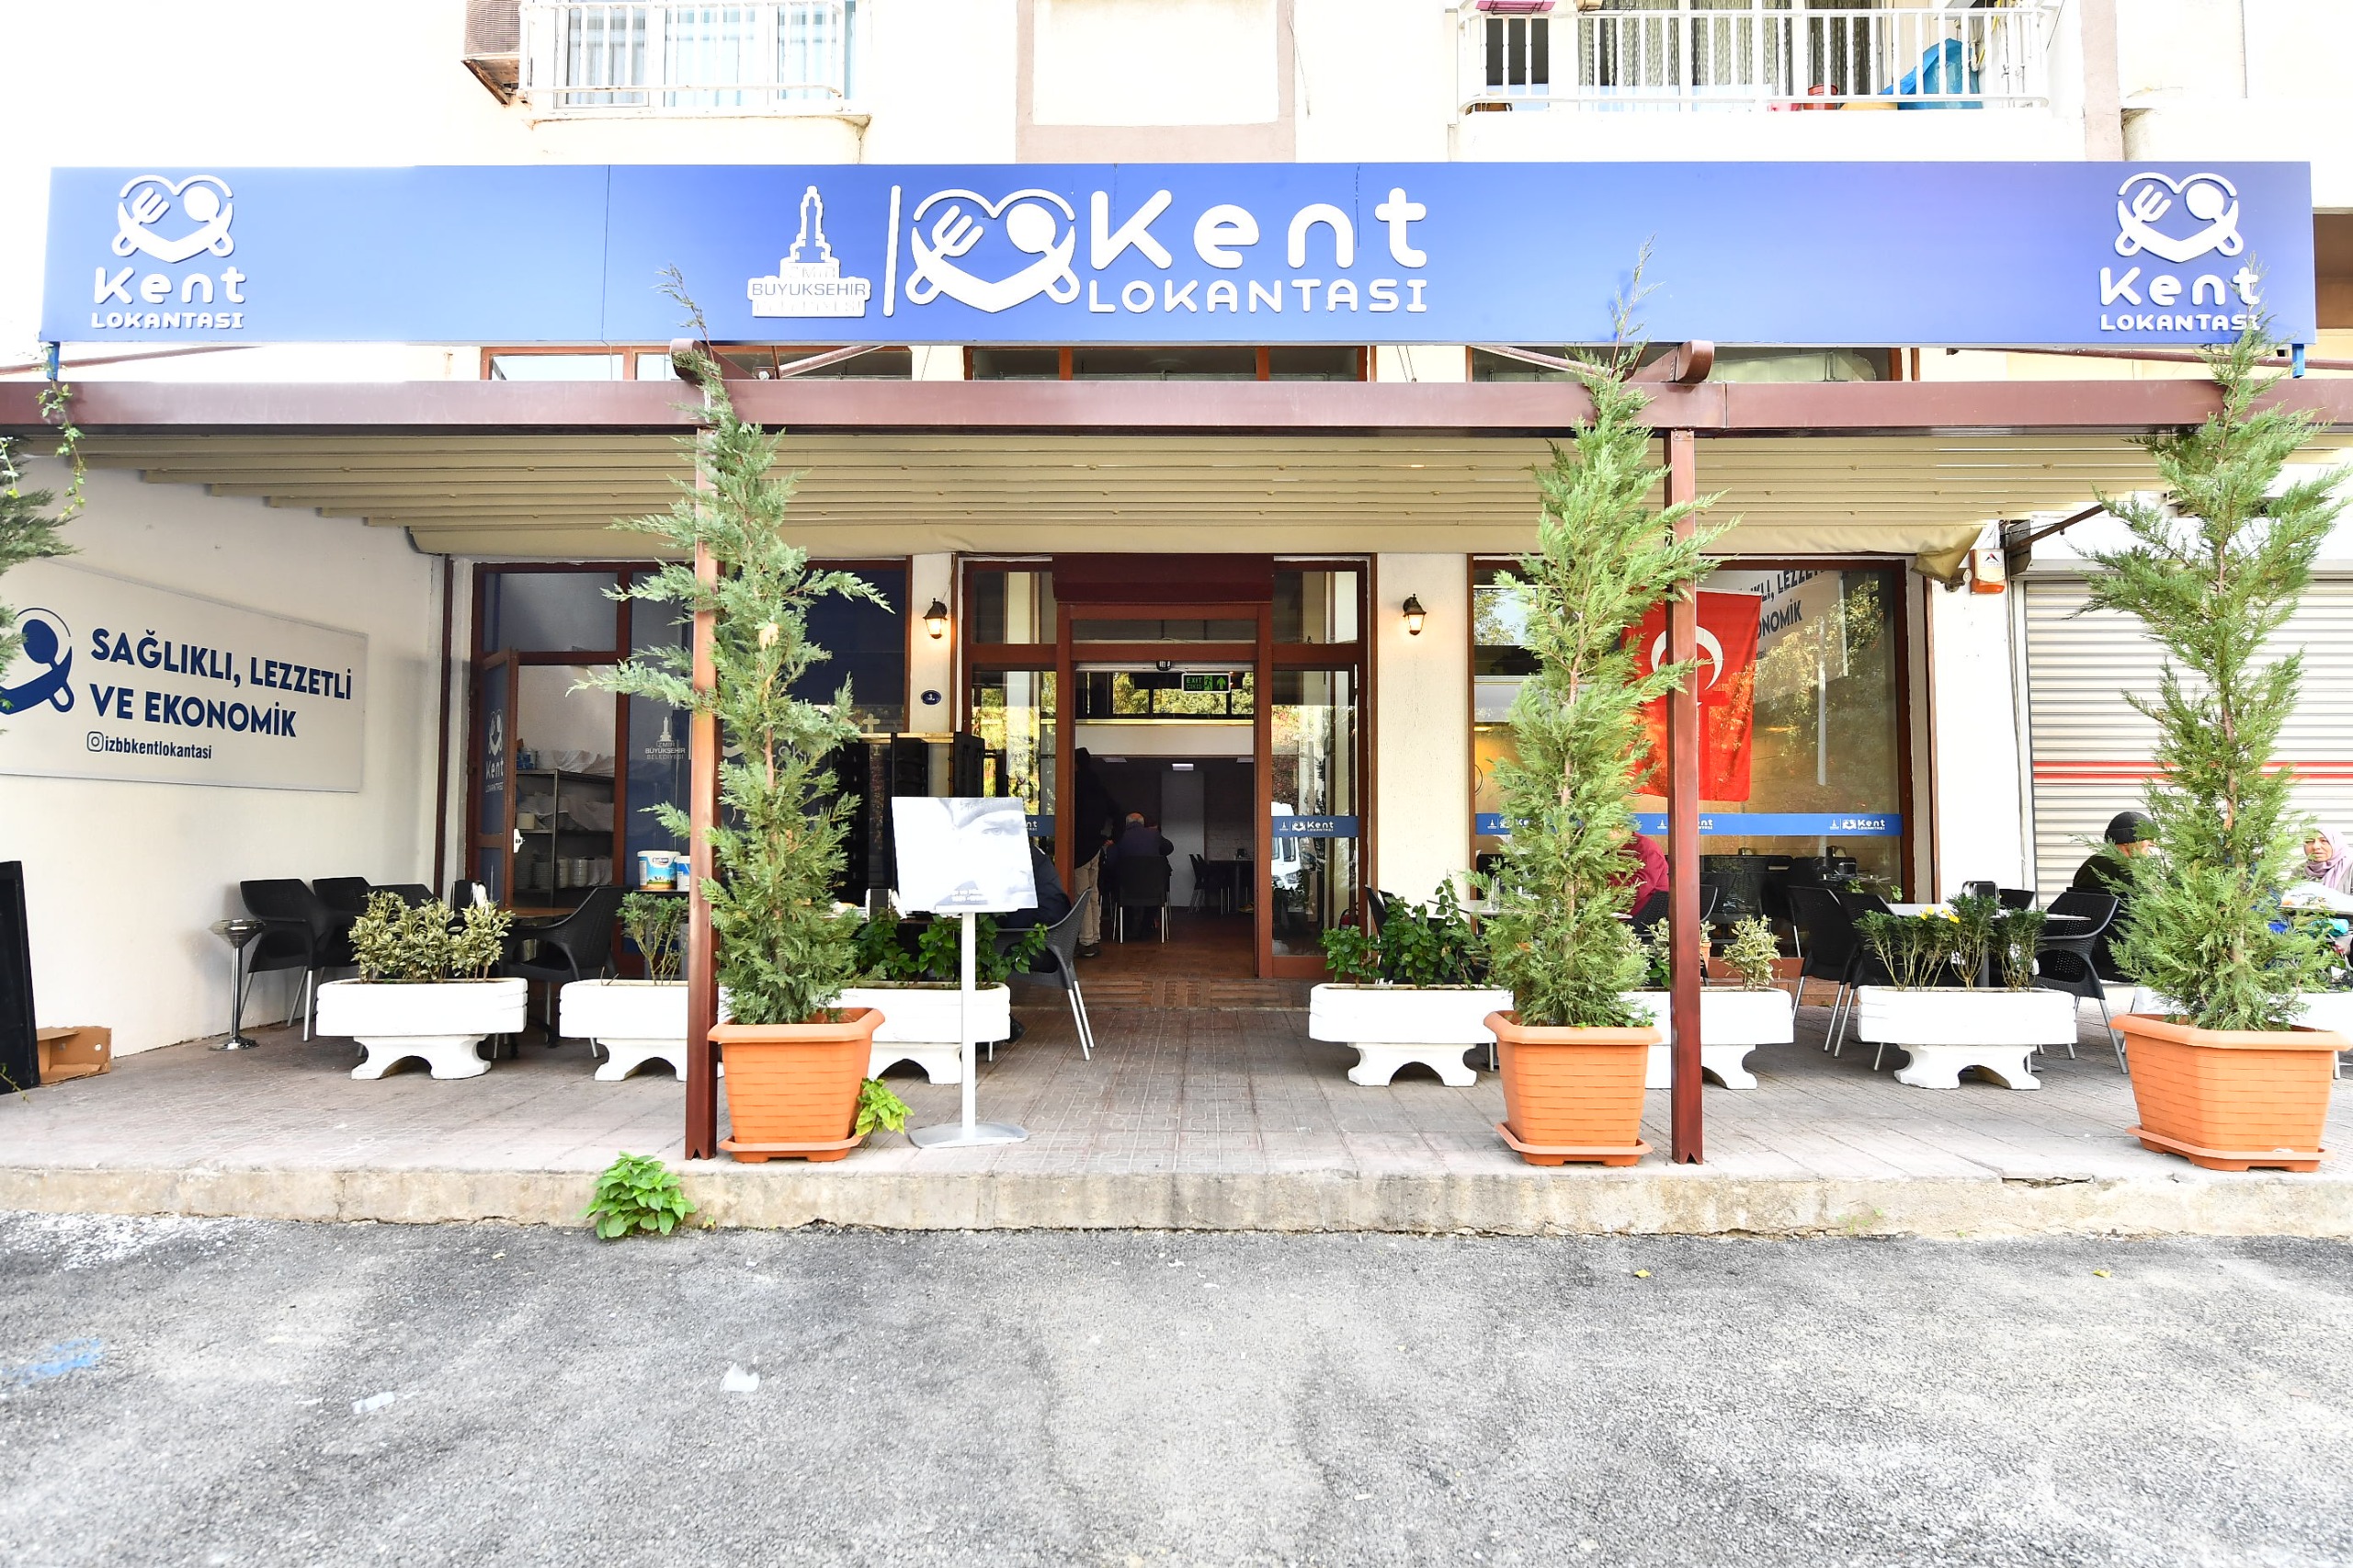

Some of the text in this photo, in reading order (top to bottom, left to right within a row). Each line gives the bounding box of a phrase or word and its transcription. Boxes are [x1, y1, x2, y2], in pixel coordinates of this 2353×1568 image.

[1090, 187, 1427, 270] Kent
[94, 266, 246, 305] Kent
[1090, 278, 1428, 314] LOKANTASI
[2100, 266, 2260, 306] Kent
[91, 312, 244, 329] LOKANTASI
[90, 627, 352, 700] SAĞLIKLI, LEZZETLİ
[89, 683, 297, 738] VE EKONOMİK
[105, 734, 212, 760] izbbkentlokantasi
[485, 756, 505, 780] Kent
[1306, 820, 1335, 829] Kent
[1857, 819, 1886, 827] Kent
